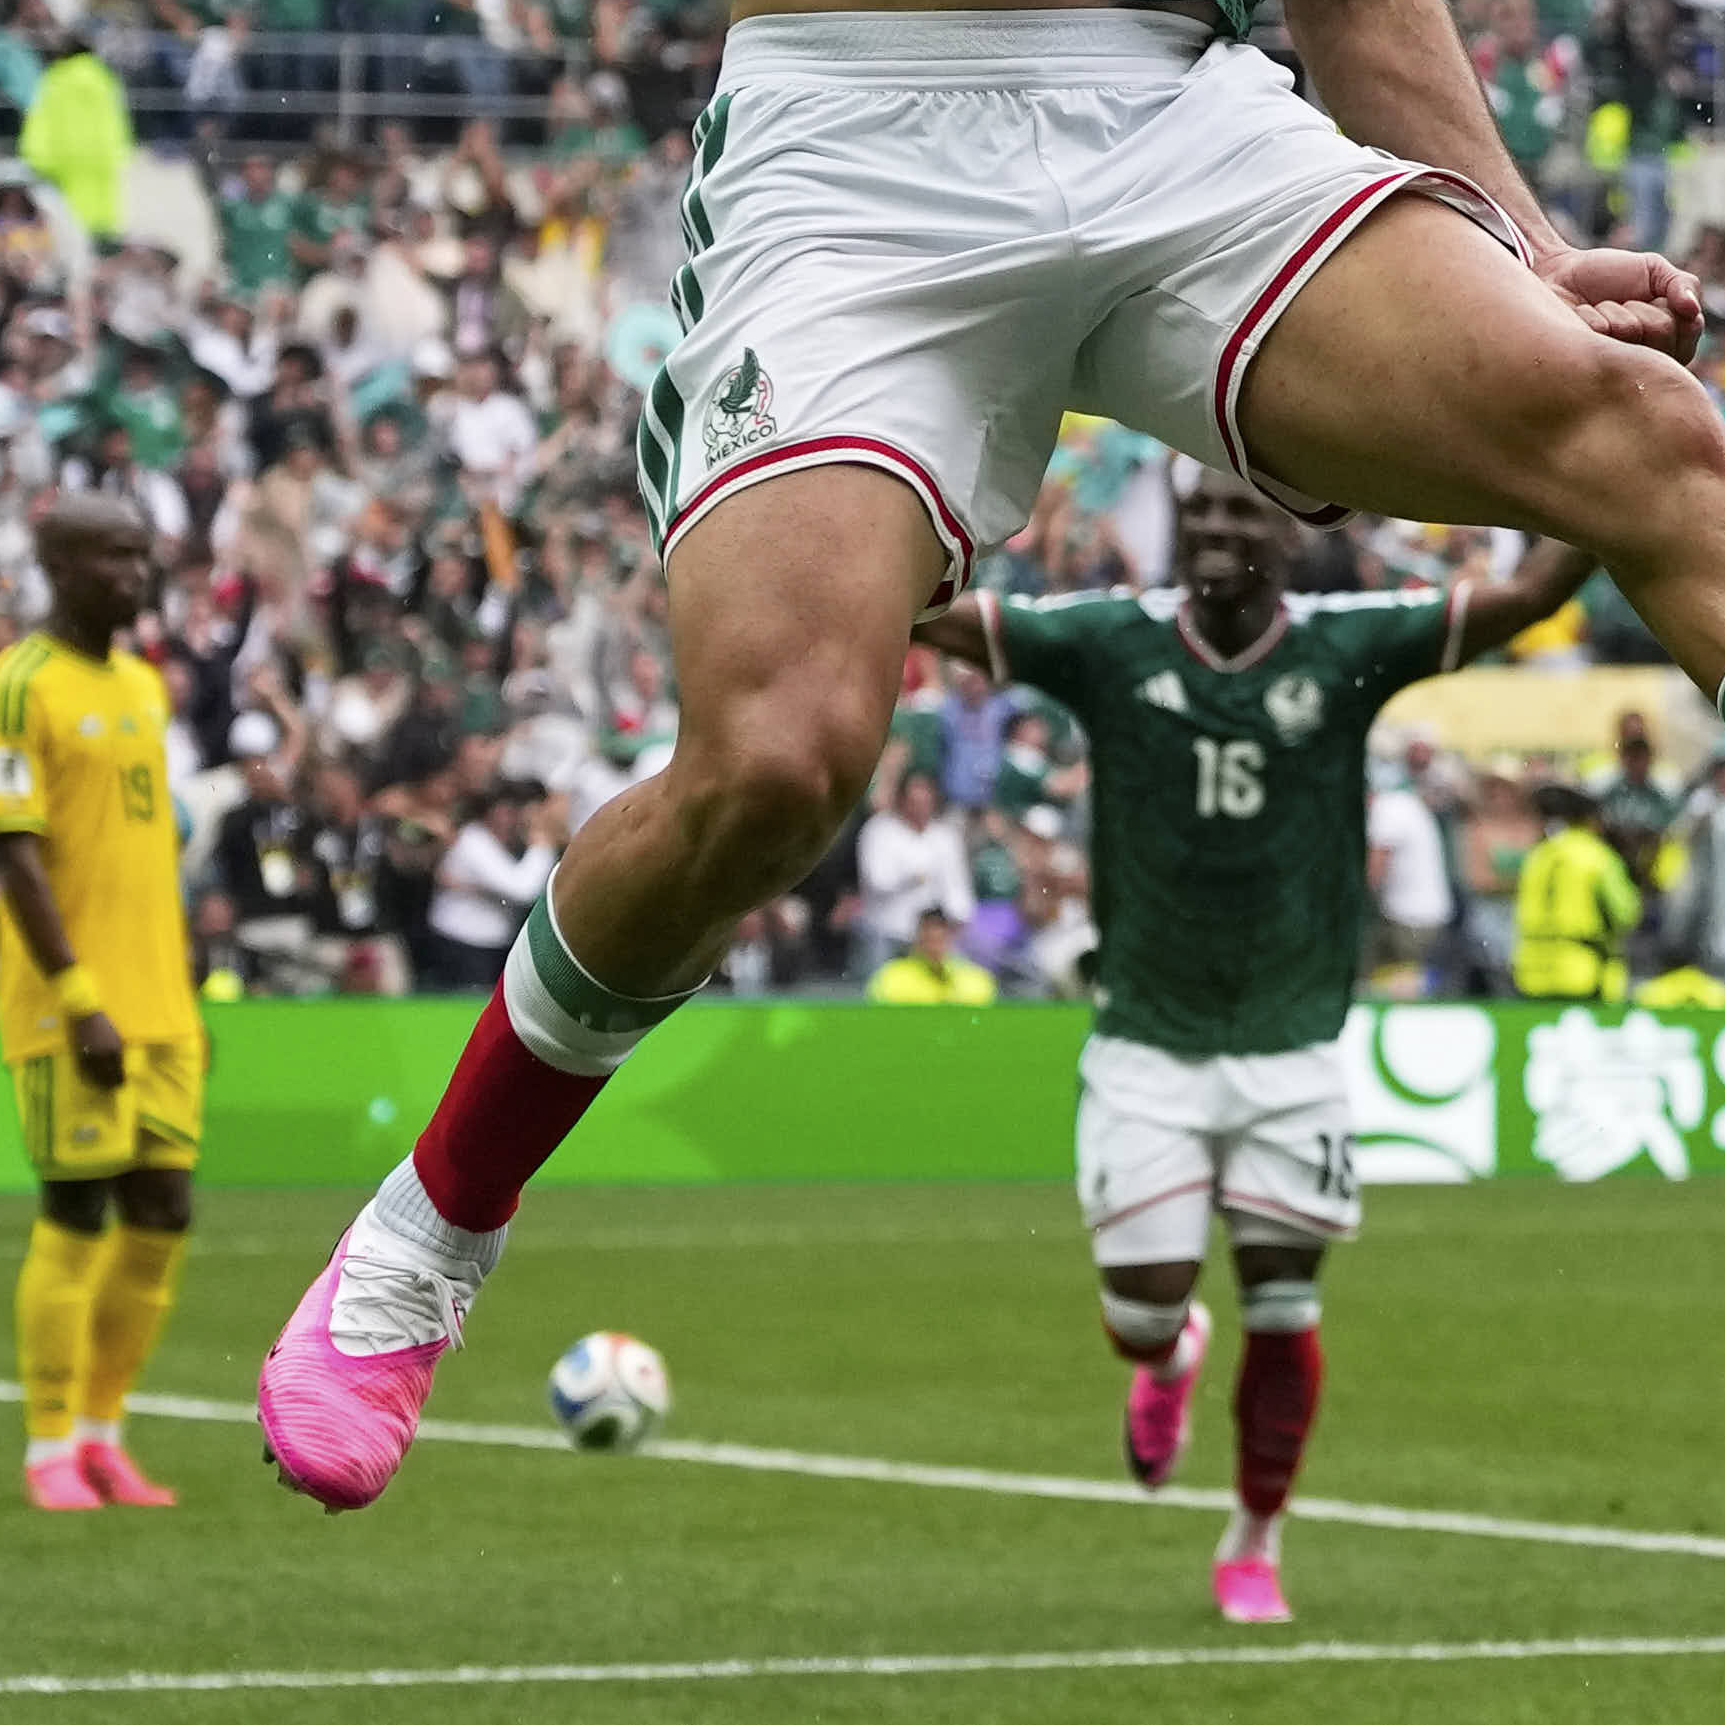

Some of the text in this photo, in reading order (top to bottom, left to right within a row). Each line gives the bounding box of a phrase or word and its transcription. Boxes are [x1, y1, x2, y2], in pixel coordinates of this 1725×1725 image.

[708, 424, 773, 468] MEXICO
[119, 762, 155, 822] 19
[1192, 736, 1267, 820] 16
